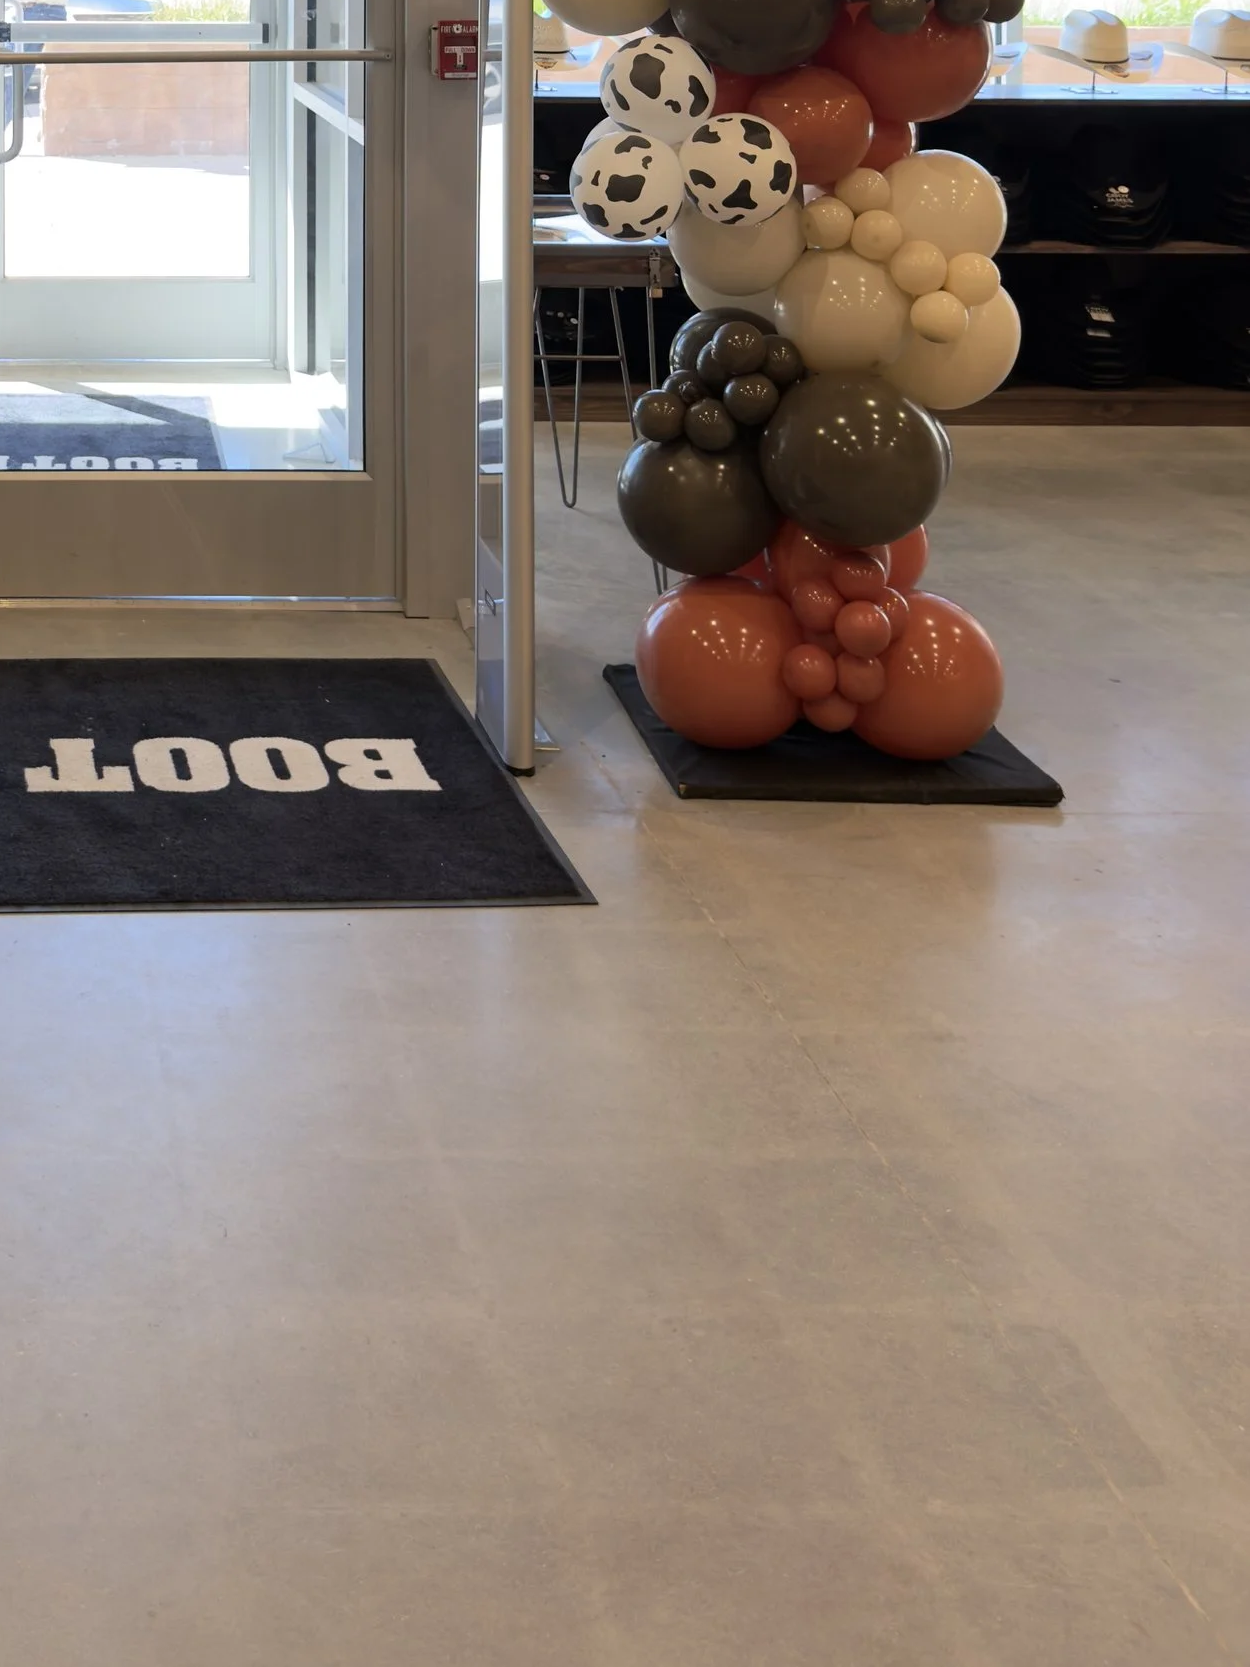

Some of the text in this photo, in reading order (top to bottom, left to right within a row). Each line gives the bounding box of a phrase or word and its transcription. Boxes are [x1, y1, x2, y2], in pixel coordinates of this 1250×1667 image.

[440, 25, 452, 33] FIRE
[21, 455, 199, 470] BOOT
[24, 737, 443, 792] BOOT
